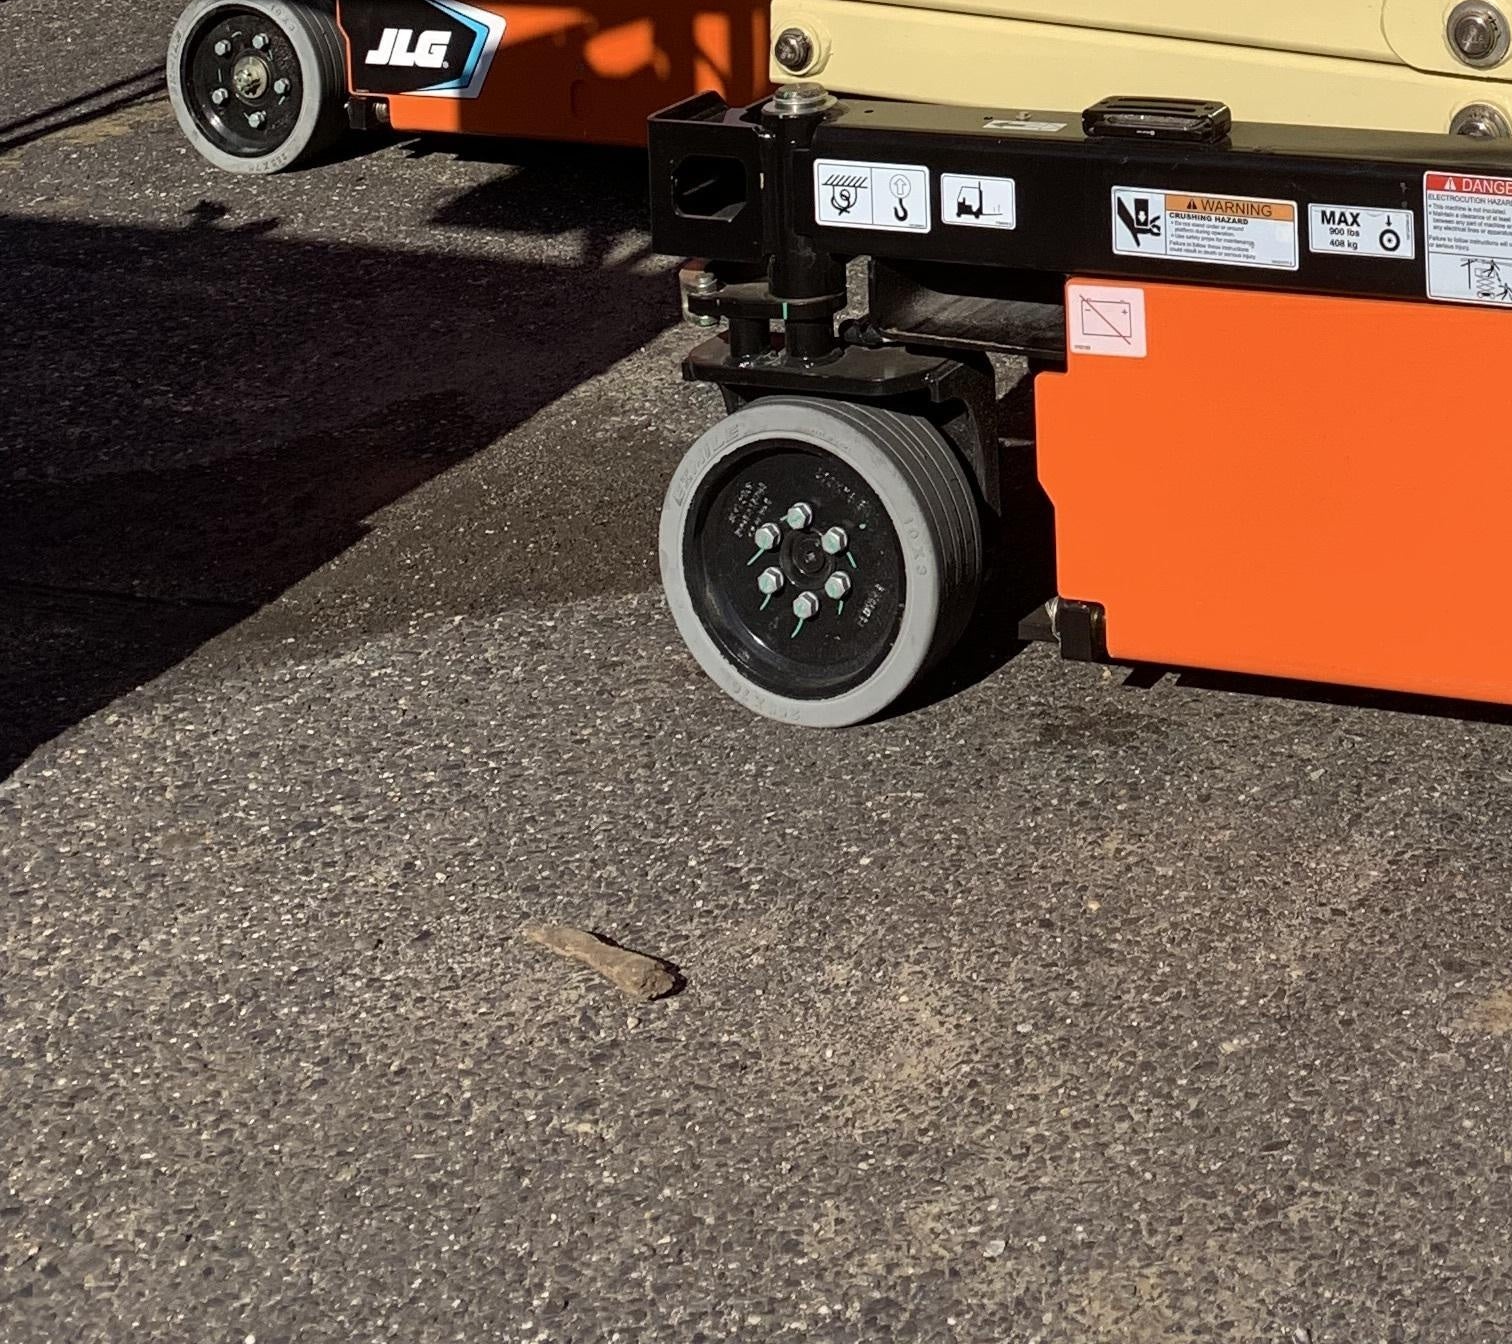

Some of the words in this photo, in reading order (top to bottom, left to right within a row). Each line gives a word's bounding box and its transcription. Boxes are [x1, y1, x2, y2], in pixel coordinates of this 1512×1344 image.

[365, 27, 452, 68] JLG
[1428, 194, 1486, 204] ELECTROCUTION
[1201, 198, 1273, 217] WARNING
[1169, 212, 1212, 222] CRUSHING
[1215, 217, 1249, 225] HAZARD
[1321, 210, 1360, 227] MAX
[1329, 227, 1344, 236] 900
[1347, 228, 1360, 237] lbs
[1329, 239, 1345, 248] 408
[1347, 240, 1358, 250] kg
